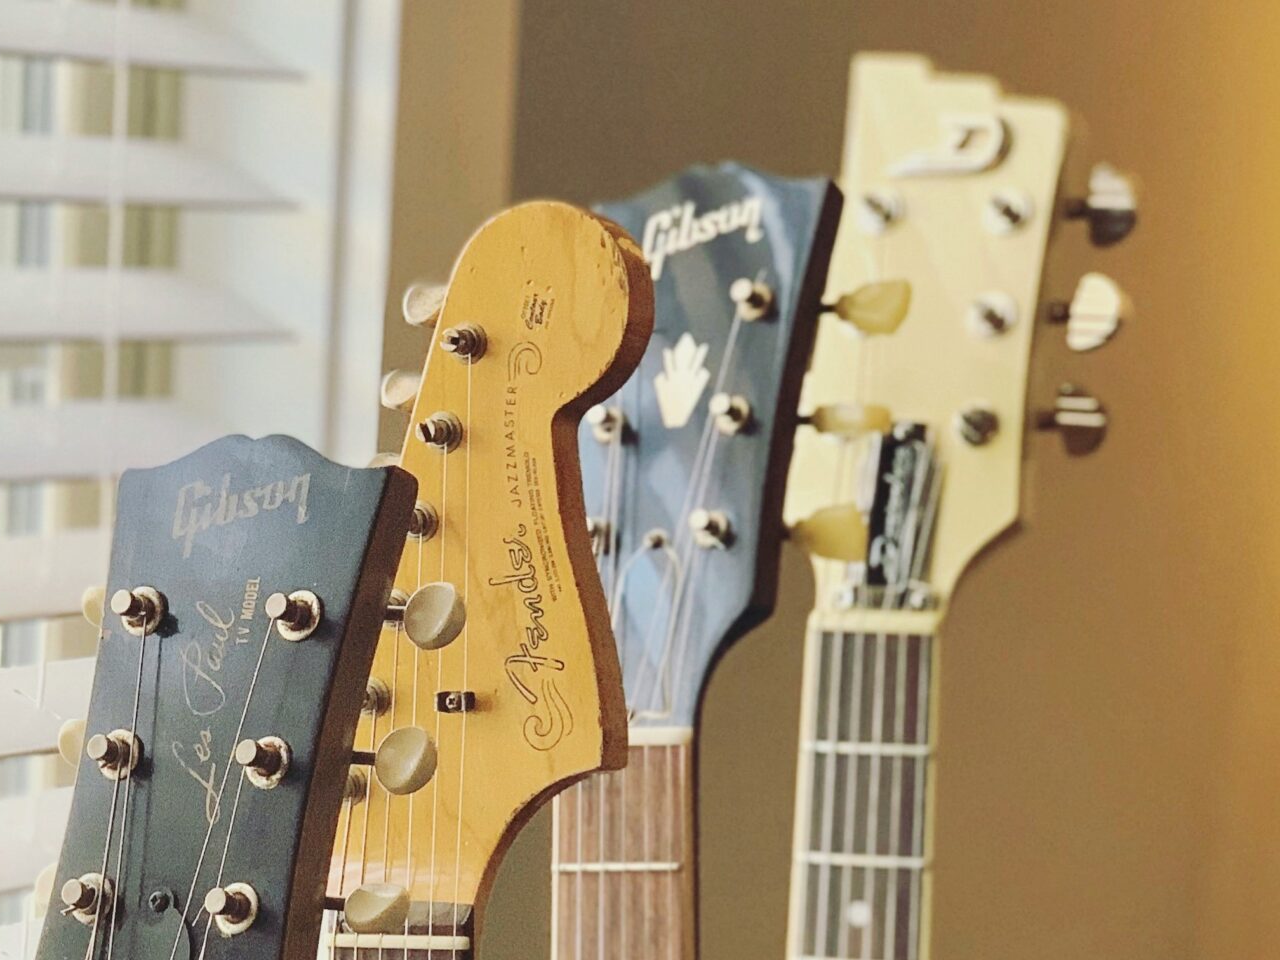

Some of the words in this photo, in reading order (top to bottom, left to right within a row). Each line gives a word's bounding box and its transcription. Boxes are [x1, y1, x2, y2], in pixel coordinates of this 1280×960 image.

[641, 195, 764, 282] Gibson
[504, 385, 521, 508] JAZZMASTER
[172, 471, 312, 560] Gibson
[235, 626, 250, 647] TV
[240, 575, 261, 622] MODEL
[488, 523, 565, 705] Fender
[180, 600, 236, 716] Paul
[172, 725, 221, 826] Les
